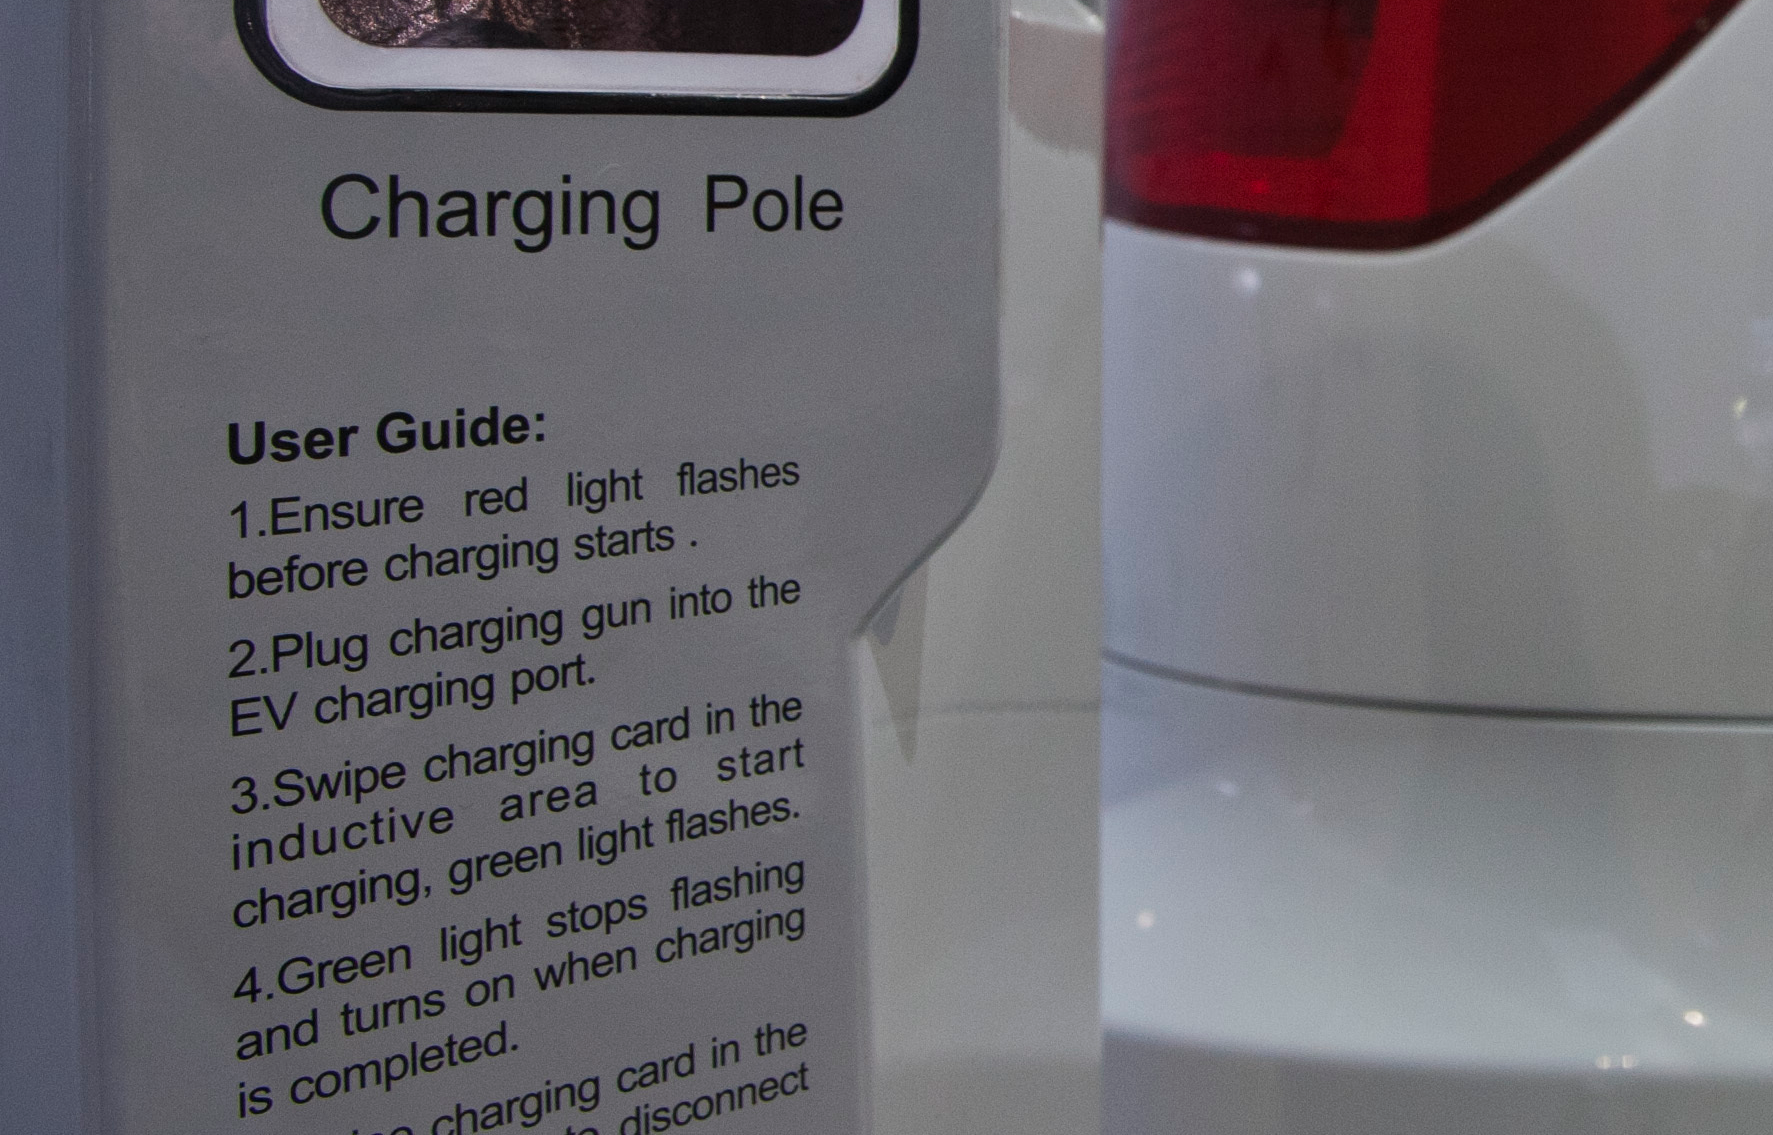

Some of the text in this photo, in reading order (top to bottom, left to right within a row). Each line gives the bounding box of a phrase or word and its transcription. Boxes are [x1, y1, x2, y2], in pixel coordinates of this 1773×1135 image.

[320, 172, 845, 254] Charging Pole
[227, 405, 548, 466] User Guide:
[230, 456, 801, 539] 1.Ensure red light flashes
[228, 557, 369, 600] before
[384, 533, 560, 582] charging
[574, 520, 676, 561] starts
[228, 574, 801, 679] 2.Plug charging gun into the
[230, 653, 596, 738] EV charging port.
[231, 693, 803, 815] 3.Swipe charging card in the
[232, 737, 805, 871] inductive area to start
[232, 790, 801, 929] charging, green light flashes.
[232, 859, 805, 1004] 4.Green light stops flashing
[236, 906, 806, 1061] and turns on when charging
[238, 1019, 519, 1119] is completed.
[430, 1022, 808, 1135] charging card in the
[619, 1061, 810, 1135] disconnect
